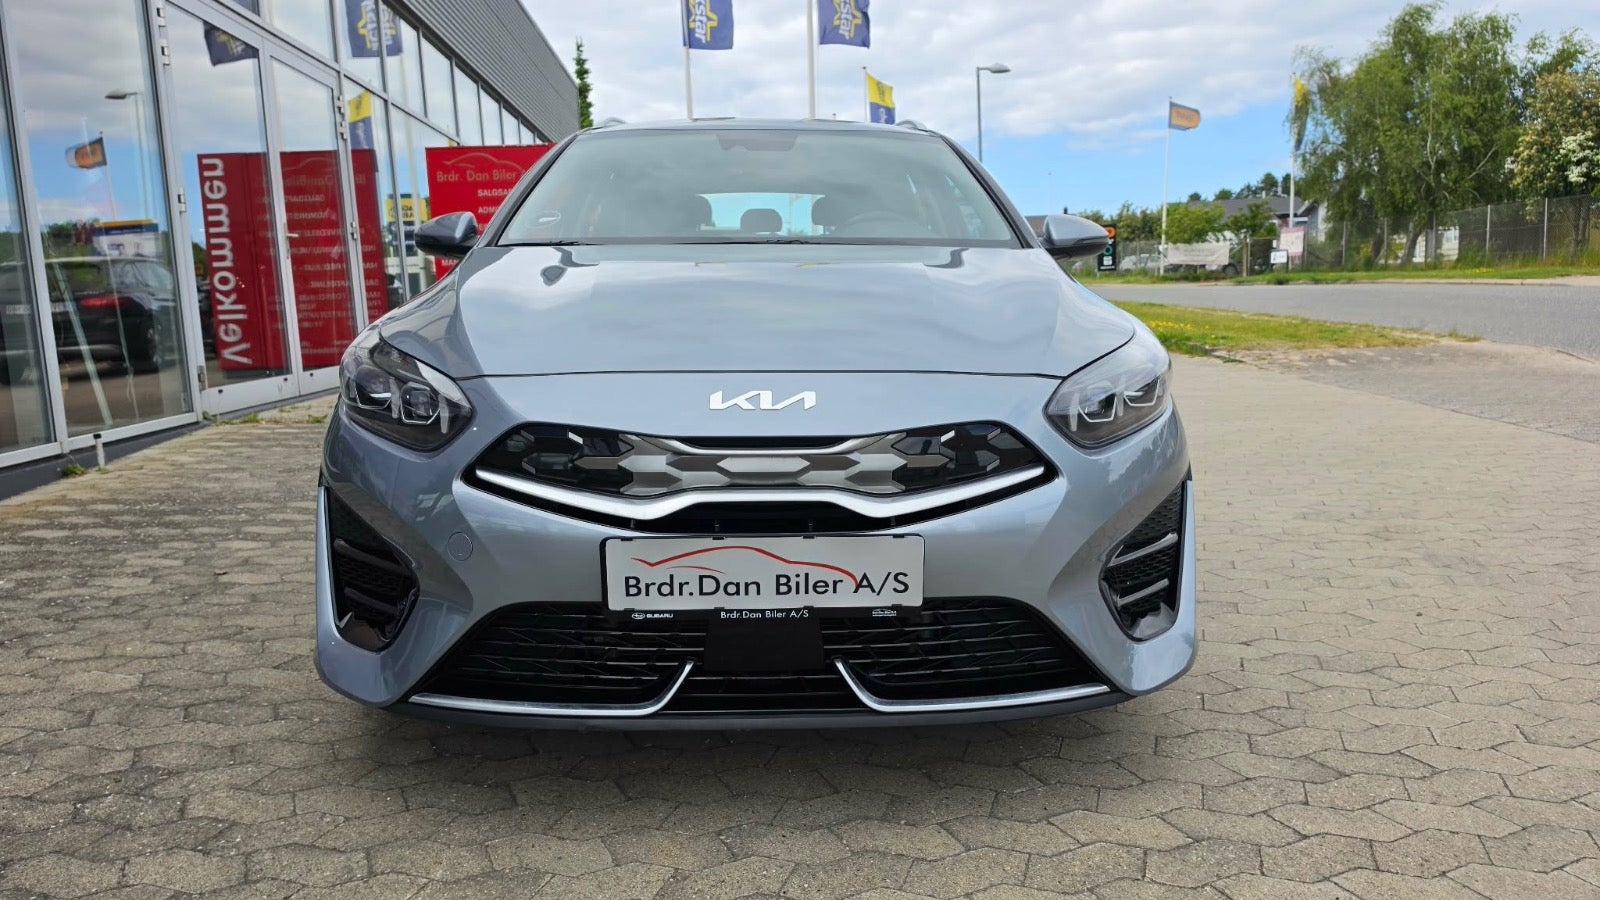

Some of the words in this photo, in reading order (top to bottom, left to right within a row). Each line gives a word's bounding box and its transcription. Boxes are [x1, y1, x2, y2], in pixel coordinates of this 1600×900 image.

[466, 170, 489, 181] Dan
[493, 169, 516, 180] Biler
[709, 390, 817, 410] KIA
[775, 572, 843, 595] Biler
[852, 571, 909, 596] A/S
[765, 610, 786, 618] Biler
[789, 609, 809, 619] A/S
